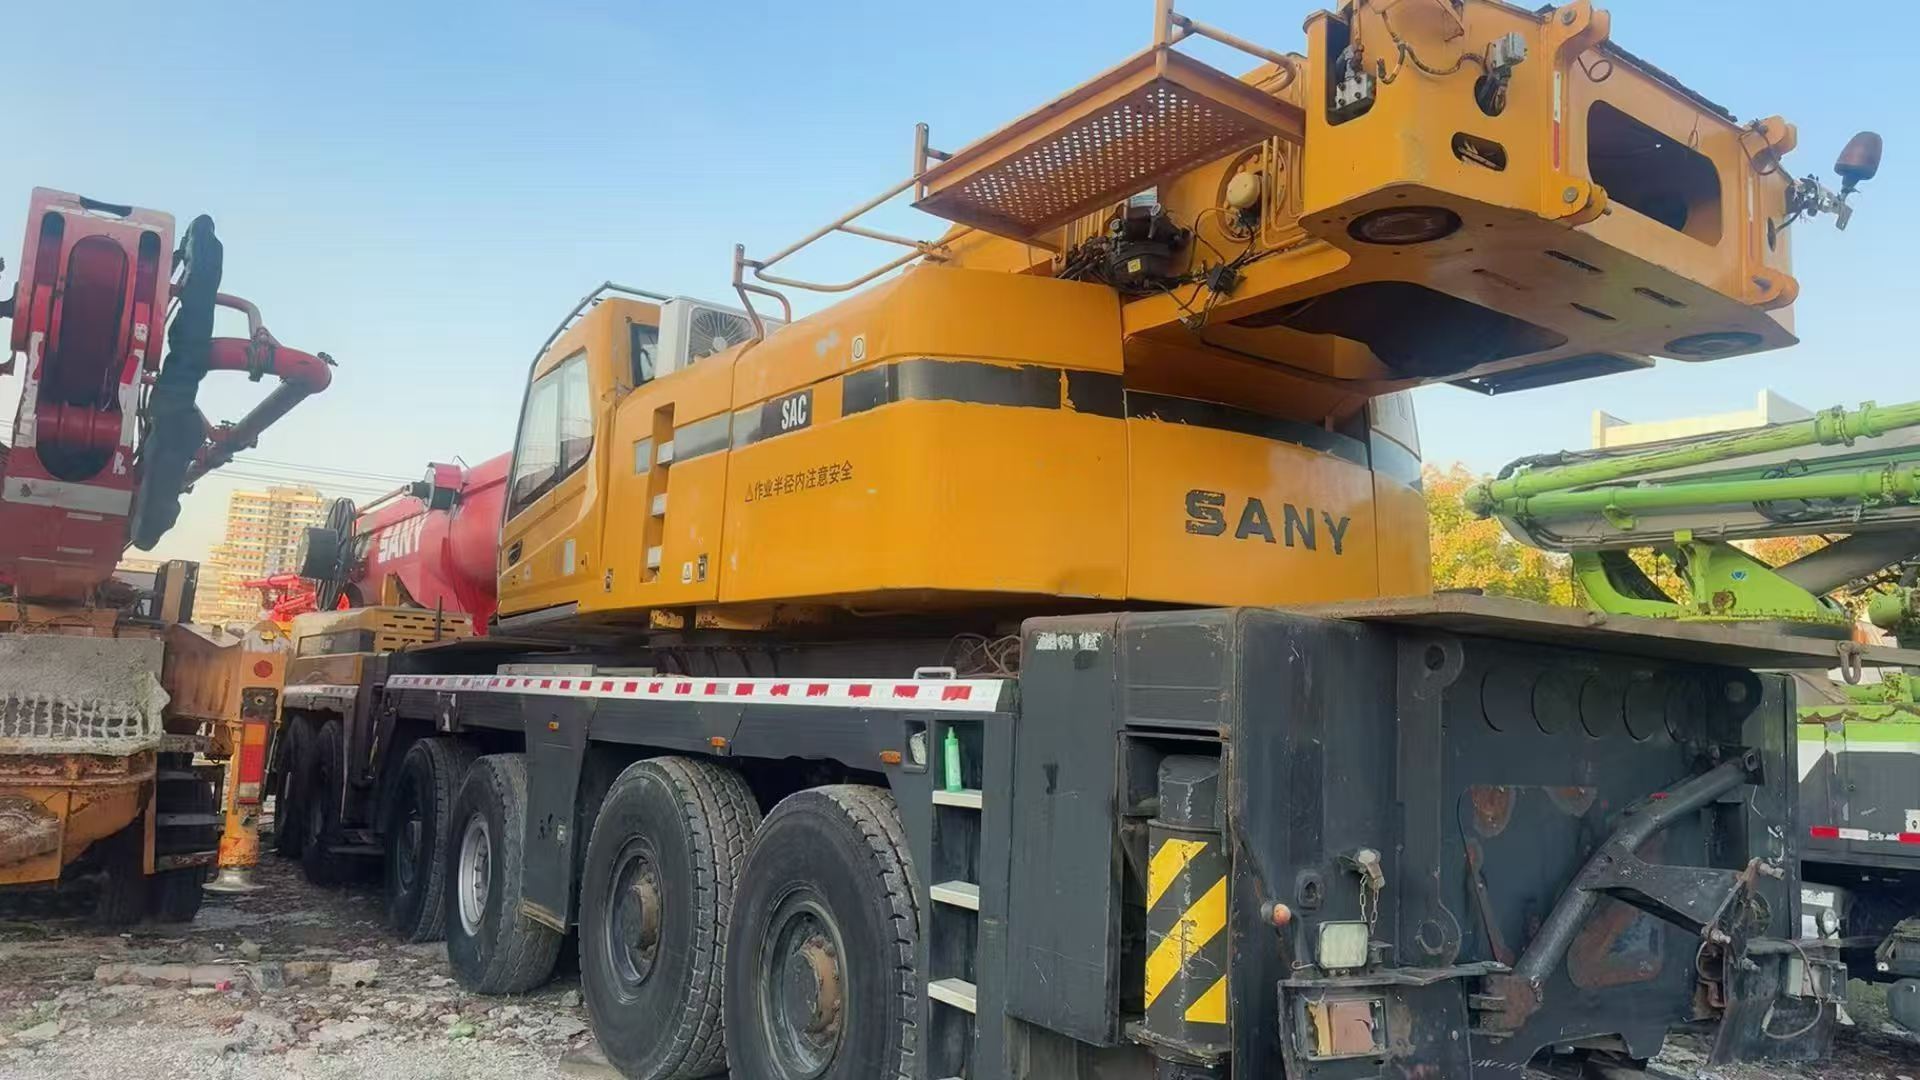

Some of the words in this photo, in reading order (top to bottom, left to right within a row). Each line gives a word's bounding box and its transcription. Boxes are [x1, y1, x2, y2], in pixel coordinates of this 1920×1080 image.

[781, 394, 807, 430] SAC
[754, 459, 853, 501] 作业半径内注意安全
[1185, 489, 1351, 555] SANY
